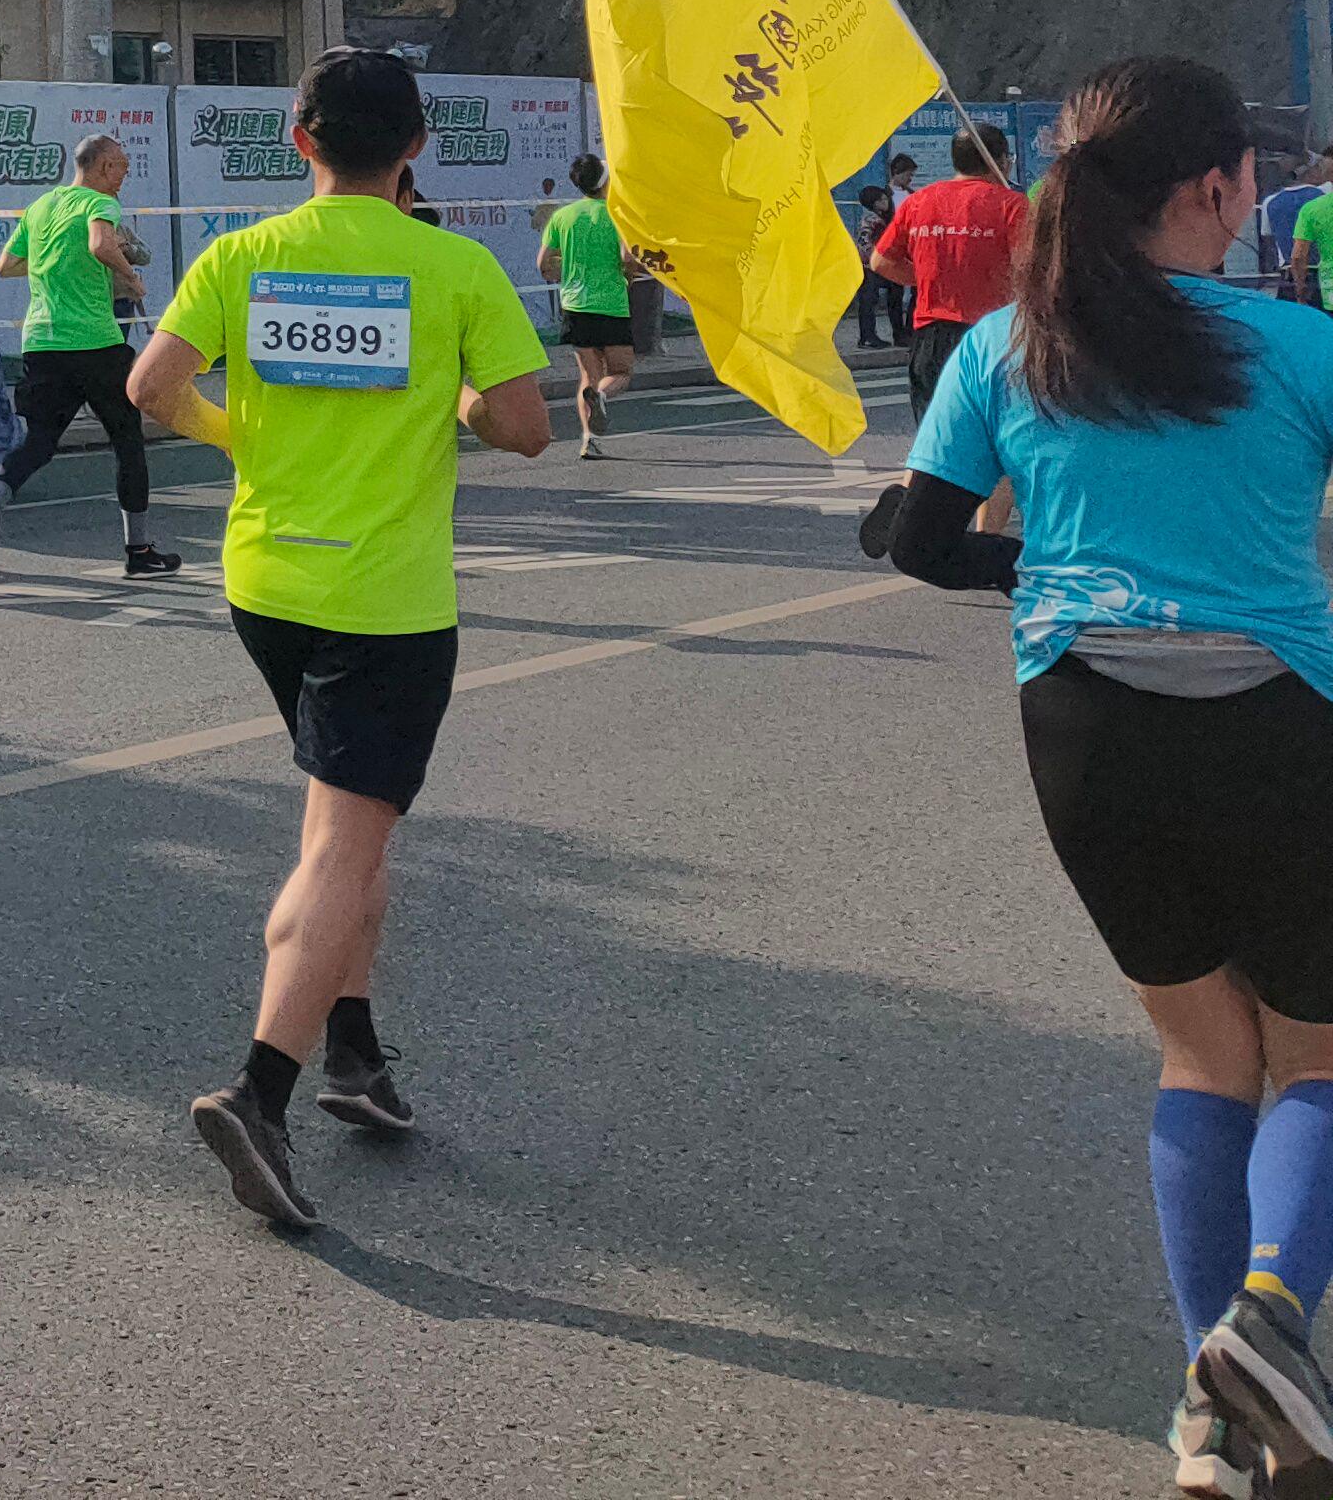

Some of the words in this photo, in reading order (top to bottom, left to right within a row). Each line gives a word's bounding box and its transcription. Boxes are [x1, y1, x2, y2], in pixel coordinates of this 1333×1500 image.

[195, 106, 281, 138] 文明健康
[224, 147, 304, 175] 有你有我
[439, 133, 505, 159] 有你有我
[261, 320, 382, 356] 36899
